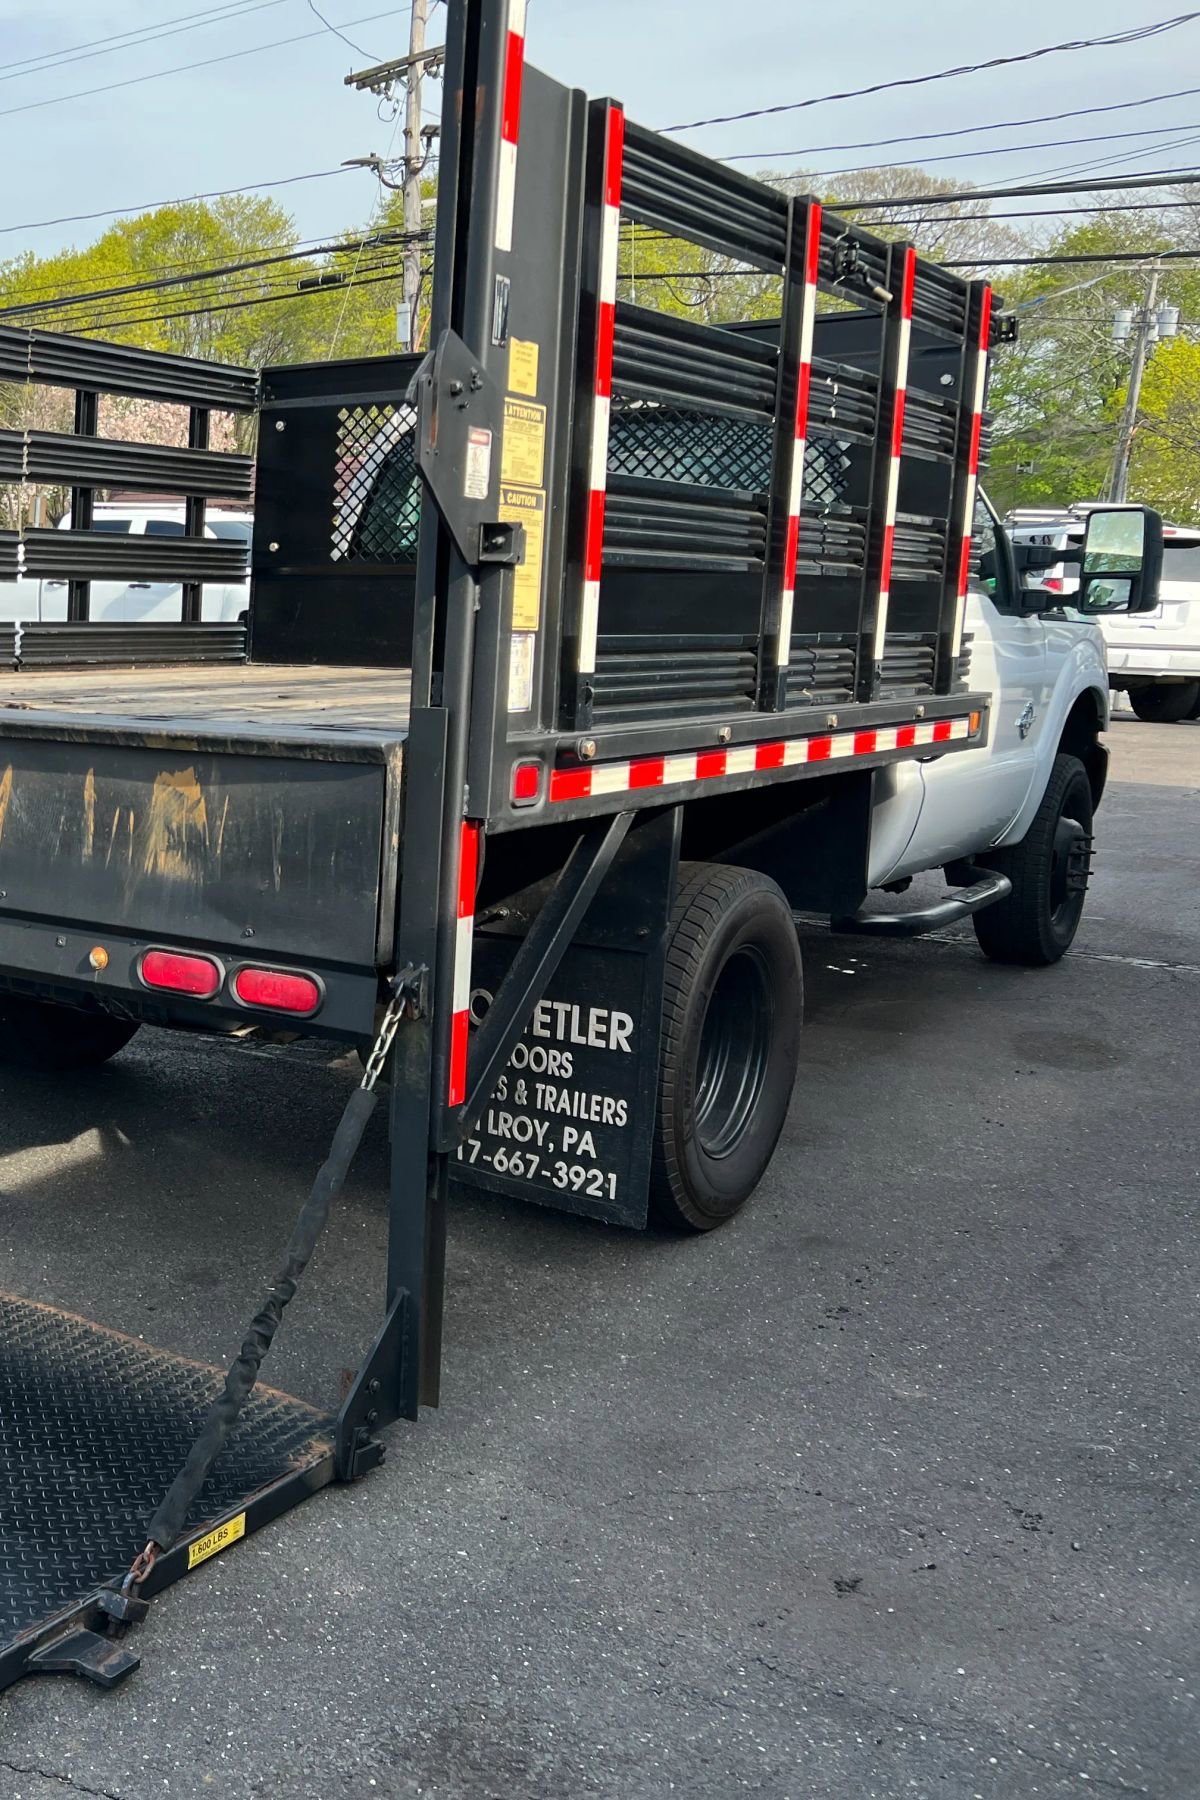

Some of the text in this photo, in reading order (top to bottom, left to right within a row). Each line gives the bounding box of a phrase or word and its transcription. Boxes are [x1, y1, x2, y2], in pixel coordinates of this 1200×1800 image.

[508, 405, 541, 421] ATTENTION
[507, 492, 537, 507] CAUTION
[507, 1043, 574, 1079] OORS
[514, 1078, 528, 1106] &
[535, 1083, 628, 1127] TRAILERS
[562, 1126, 597, 1159] PA
[457, 1138, 617, 1200] 17-667-3921
[213, 1528, 229, 1544] LBS
